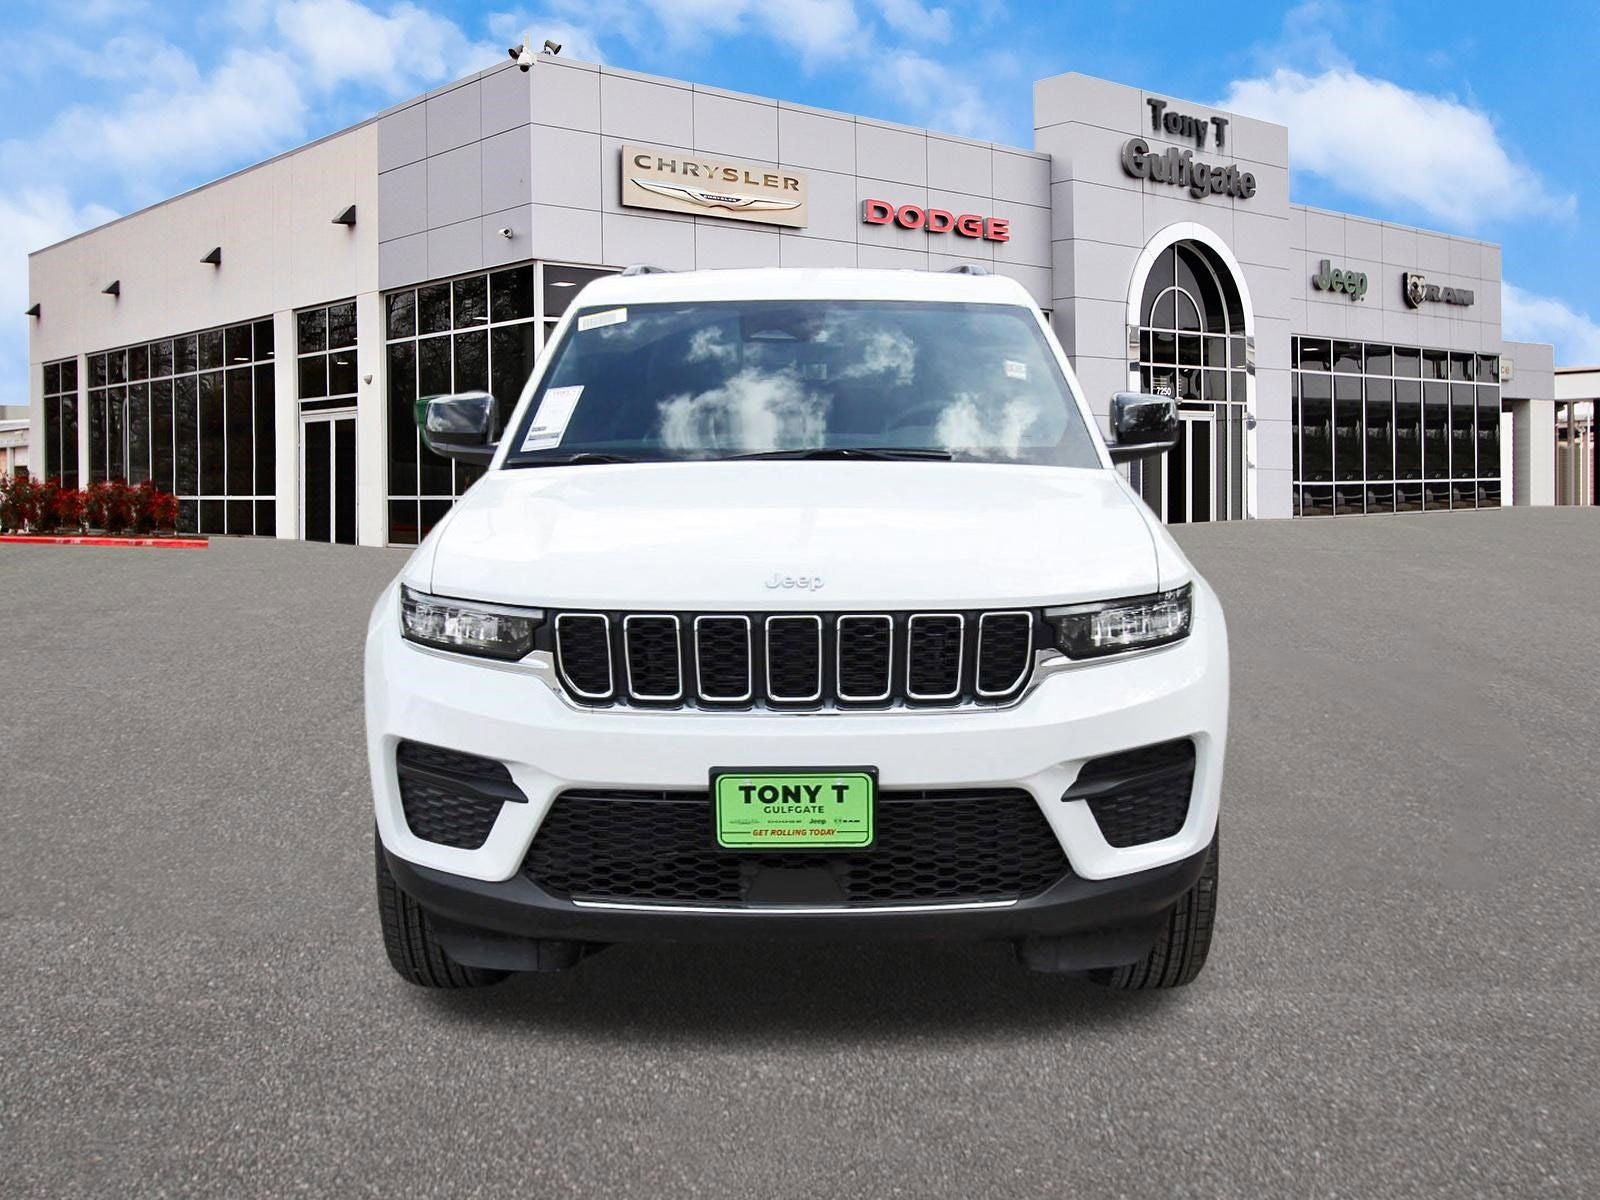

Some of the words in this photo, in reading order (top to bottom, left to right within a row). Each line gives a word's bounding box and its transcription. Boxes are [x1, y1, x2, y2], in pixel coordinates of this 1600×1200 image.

[1146, 98, 1208, 147] Tony
[1210, 117, 1229, 147] T
[633, 154, 800, 191] CHRYSLER
[1121, 138, 1257, 199] Gulfgate
[862, 199, 1010, 242] DODGE
[1312, 259, 1368, 302] Jeep
[1425, 284, 1475, 306] RAM
[1156, 386, 1172, 396] 7250
[765, 572, 824, 592] Jeep
[738, 784, 822, 804] TONY
[831, 784, 849, 804] T
[763, 805, 825, 814] GULFGATE
